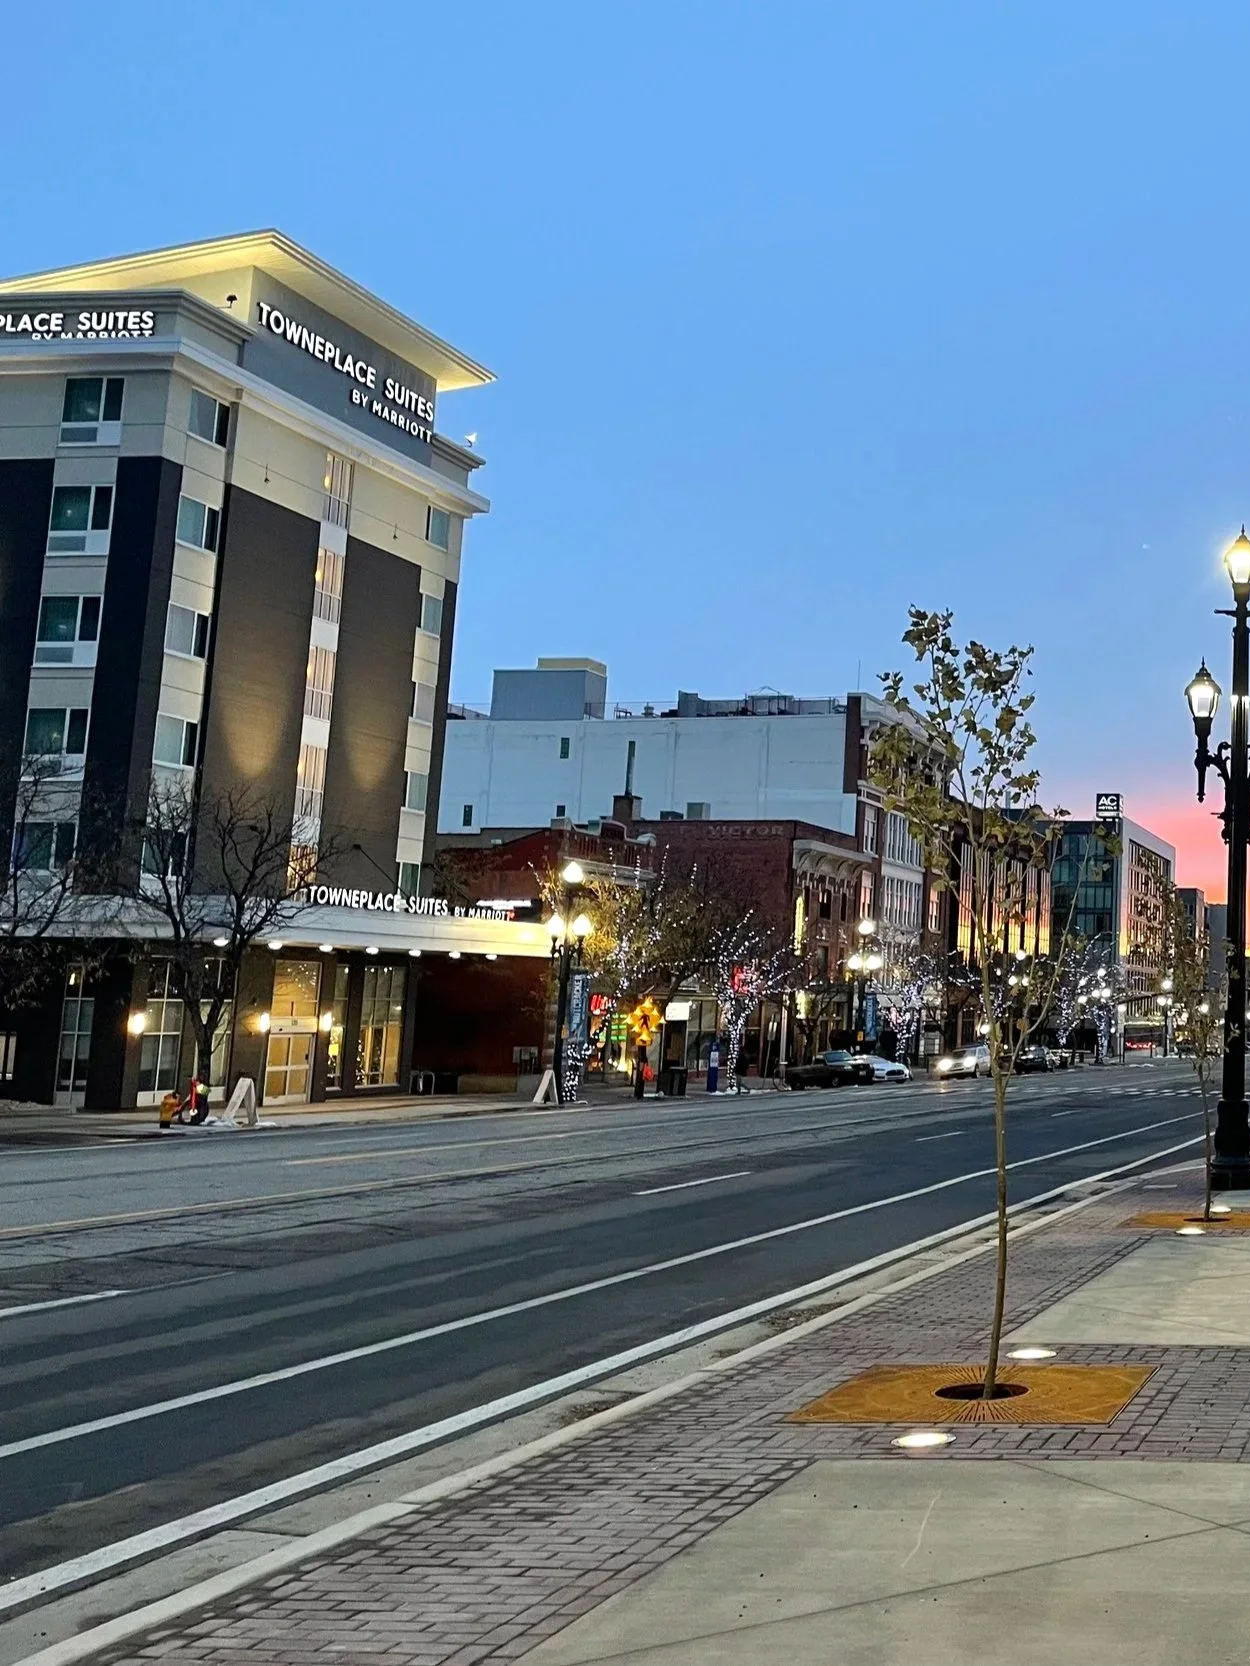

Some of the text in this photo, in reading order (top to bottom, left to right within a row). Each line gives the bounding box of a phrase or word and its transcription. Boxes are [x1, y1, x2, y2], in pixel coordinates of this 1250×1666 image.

[77, 311, 154, 331] SUITES
[259, 302, 434, 422] TOWNEPLACE SUITES
[352, 389, 433, 444] BY MARRIOTT
[1098, 796, 1117, 806] AC
[708, 825, 784, 835] VICTOR
[309, 885, 511, 922] TOWNEPLACE SUITES BY MARRIOTT
[573, 974, 583, 1023] NUTCRACKER
